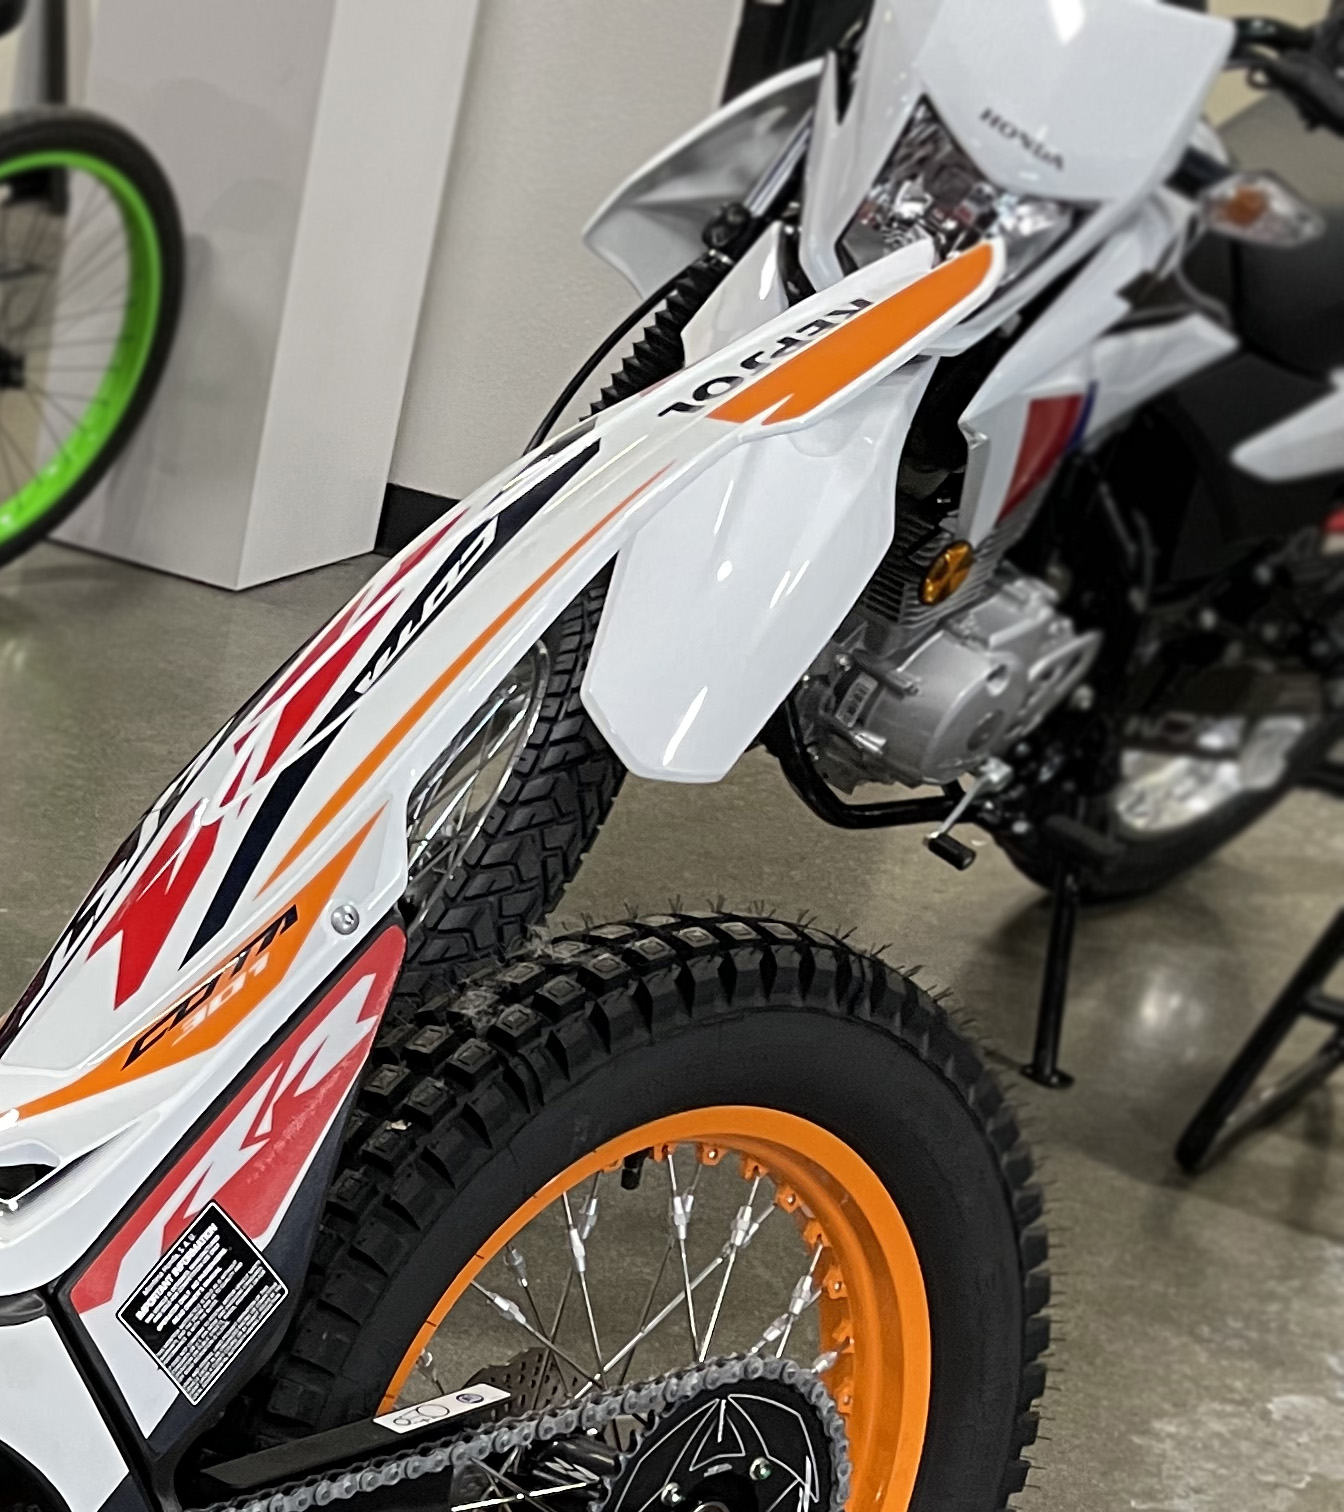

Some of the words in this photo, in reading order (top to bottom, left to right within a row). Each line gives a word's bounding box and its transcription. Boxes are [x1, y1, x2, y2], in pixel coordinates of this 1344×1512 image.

[979, 107, 1064, 171] HONDA
[171, 951, 271, 1048] 301
[133, 1272, 176, 1322] IMPORTANT
[169, 1220, 219, 1278] INFORMATION
